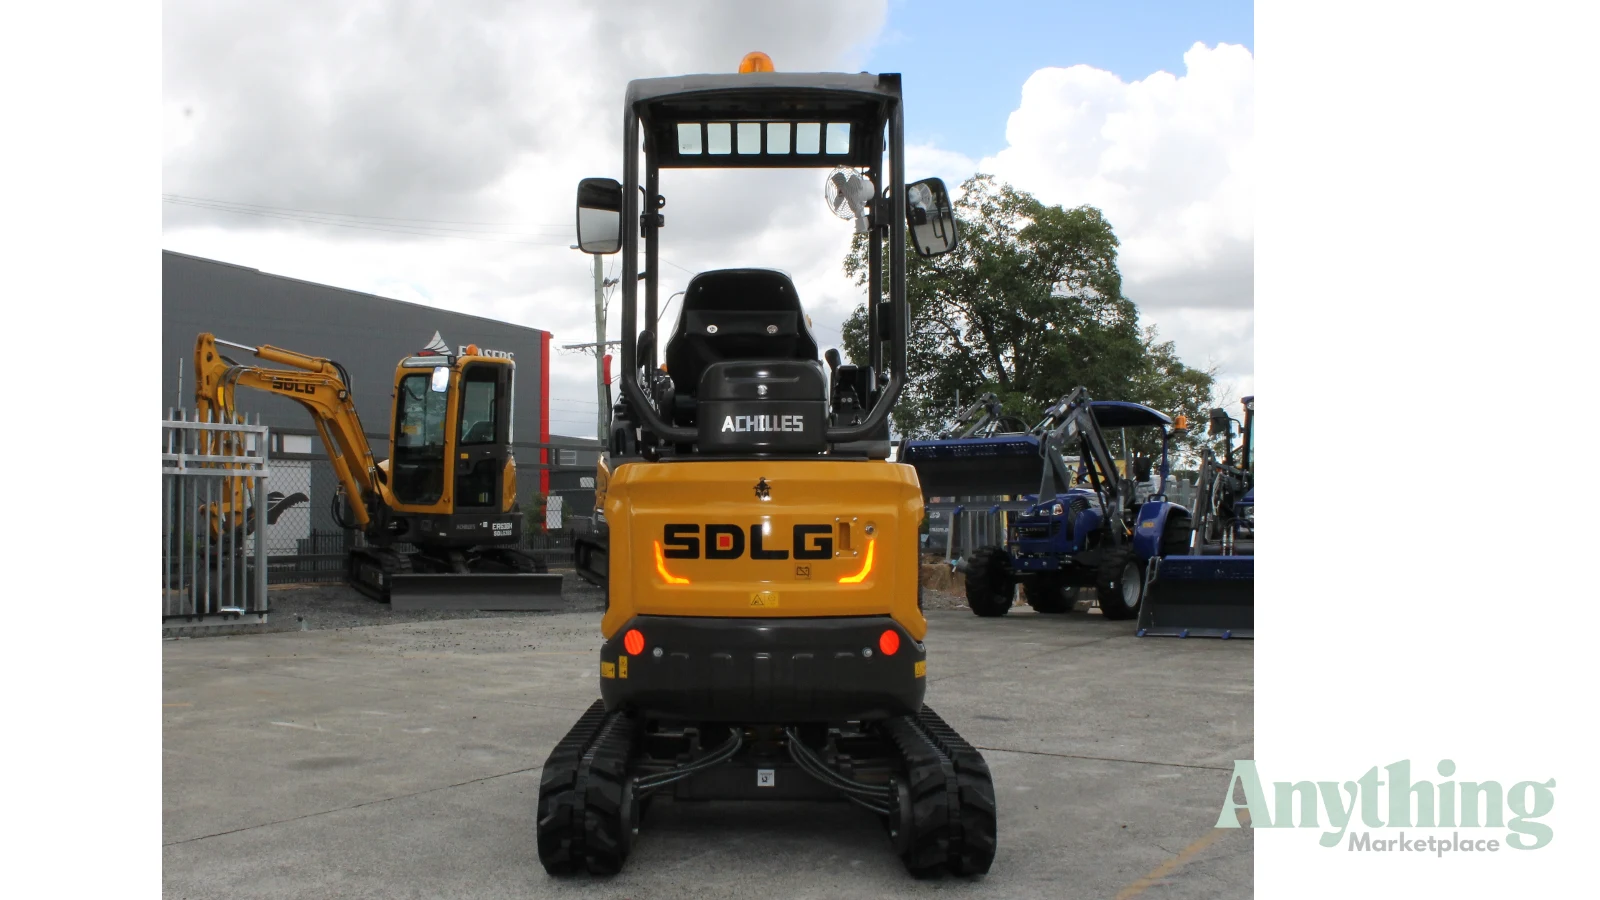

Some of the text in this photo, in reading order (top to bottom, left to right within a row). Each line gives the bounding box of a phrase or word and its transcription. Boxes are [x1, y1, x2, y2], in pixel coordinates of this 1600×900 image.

[457, 345, 514, 360] FASERS
[272, 376, 315, 394] SDLG
[721, 414, 804, 432] ACHILLES
[663, 523, 833, 560] SDLG
